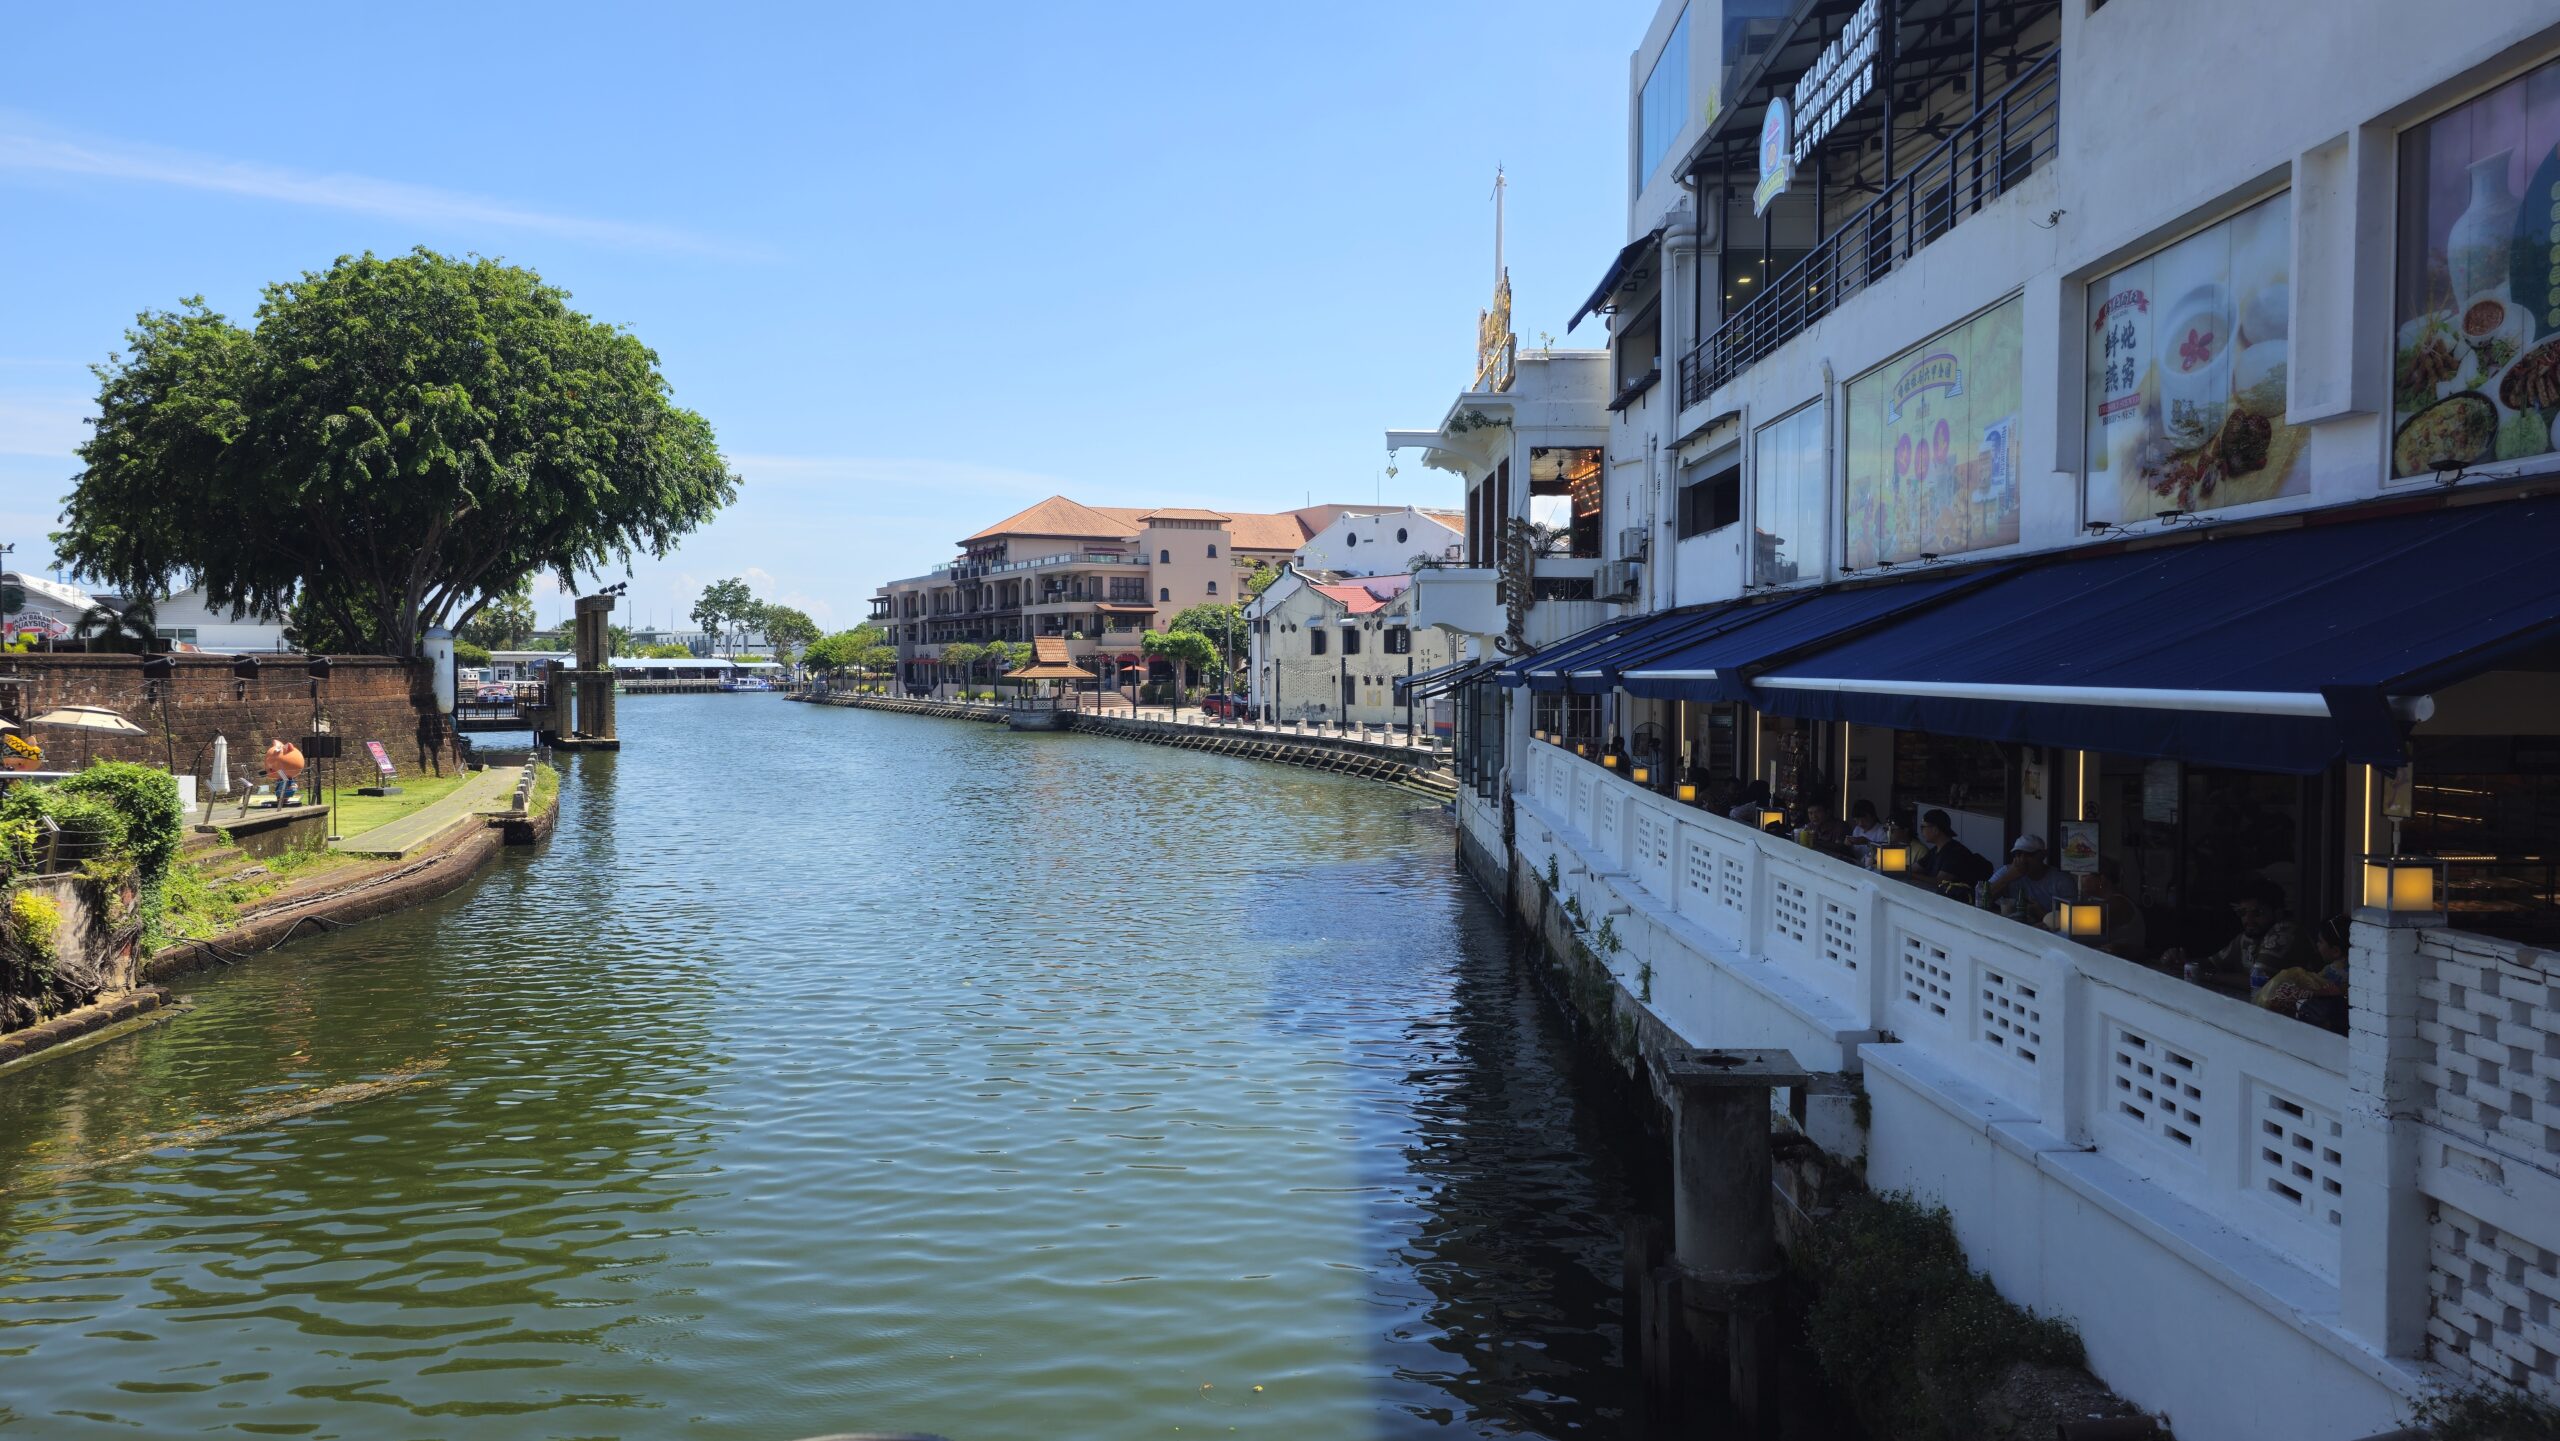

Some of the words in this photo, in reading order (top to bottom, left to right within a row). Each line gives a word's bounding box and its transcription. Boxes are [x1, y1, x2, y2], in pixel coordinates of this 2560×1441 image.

[1794, 88, 1826, 138] NYONYA
[1826, 26, 1878, 104] RESTAURANT
[1795, 41, 1840, 110] MELAKA
[1843, 0, 1878, 55] RIVER
[12, 615, 28, 625] IKAN
[28, 614, 51, 623] BAKAR
[13, 620, 52, 631] QUAYSIDE
